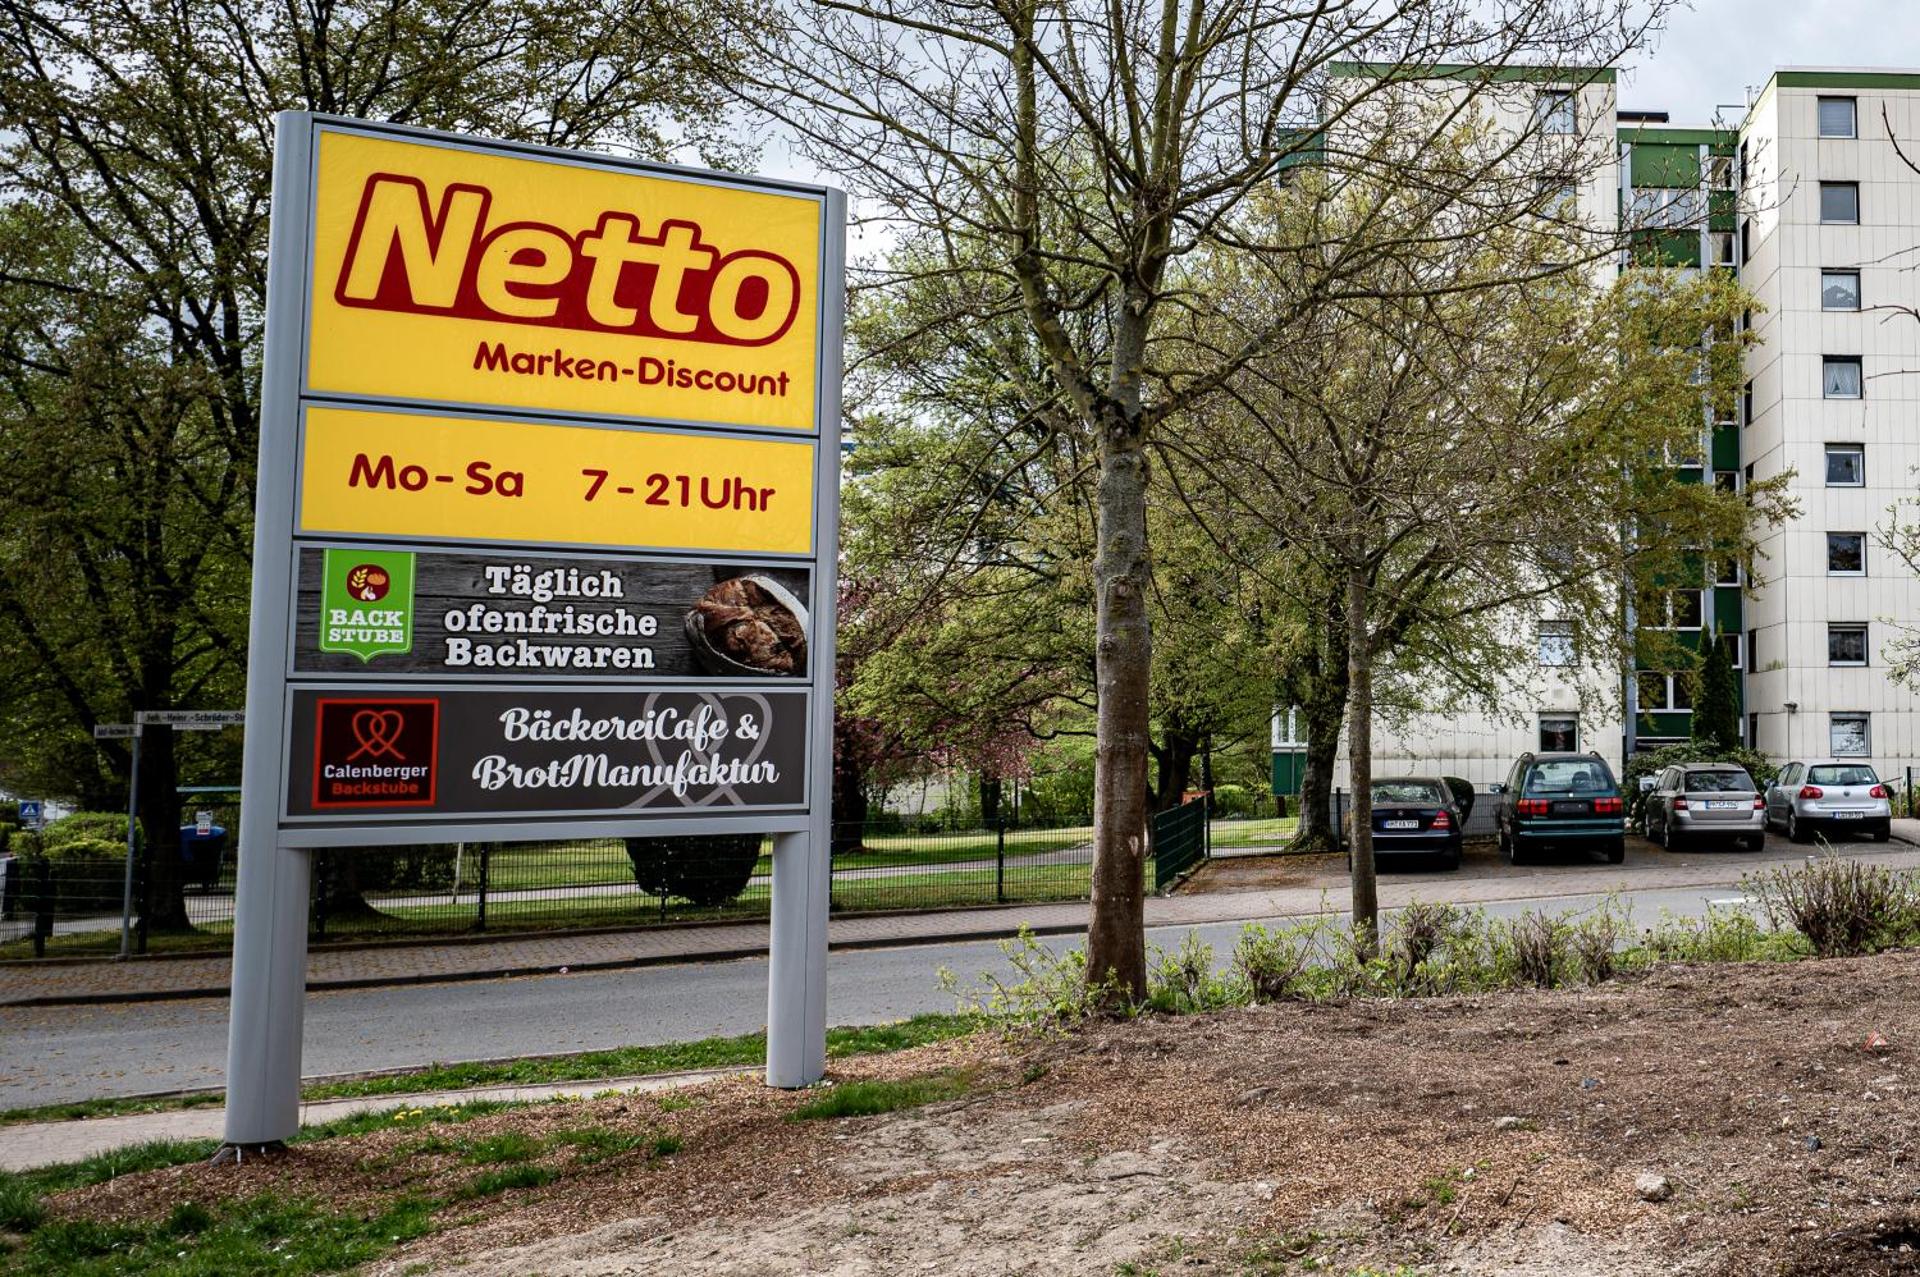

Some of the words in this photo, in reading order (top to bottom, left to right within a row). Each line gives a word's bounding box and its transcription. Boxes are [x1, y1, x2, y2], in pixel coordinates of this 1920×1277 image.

[335, 172, 800, 347] Netto
[474, 341, 790, 397] Marken-Discount
[701, 476, 776, 512] Uhr
[485, 564, 624, 602] Täglich
[328, 627, 404, 643] STUBE
[329, 609, 404, 627] BACK
[444, 604, 658, 636] ofenfrische
[444, 638, 655, 669] Backwaren
[500, 704, 729, 752] BäckereiCafe
[735, 713, 760, 740] &
[324, 764, 428, 780] Calenberger
[332, 781, 419, 795] Backstube
[472, 749, 780, 797] BrotManufaktur
